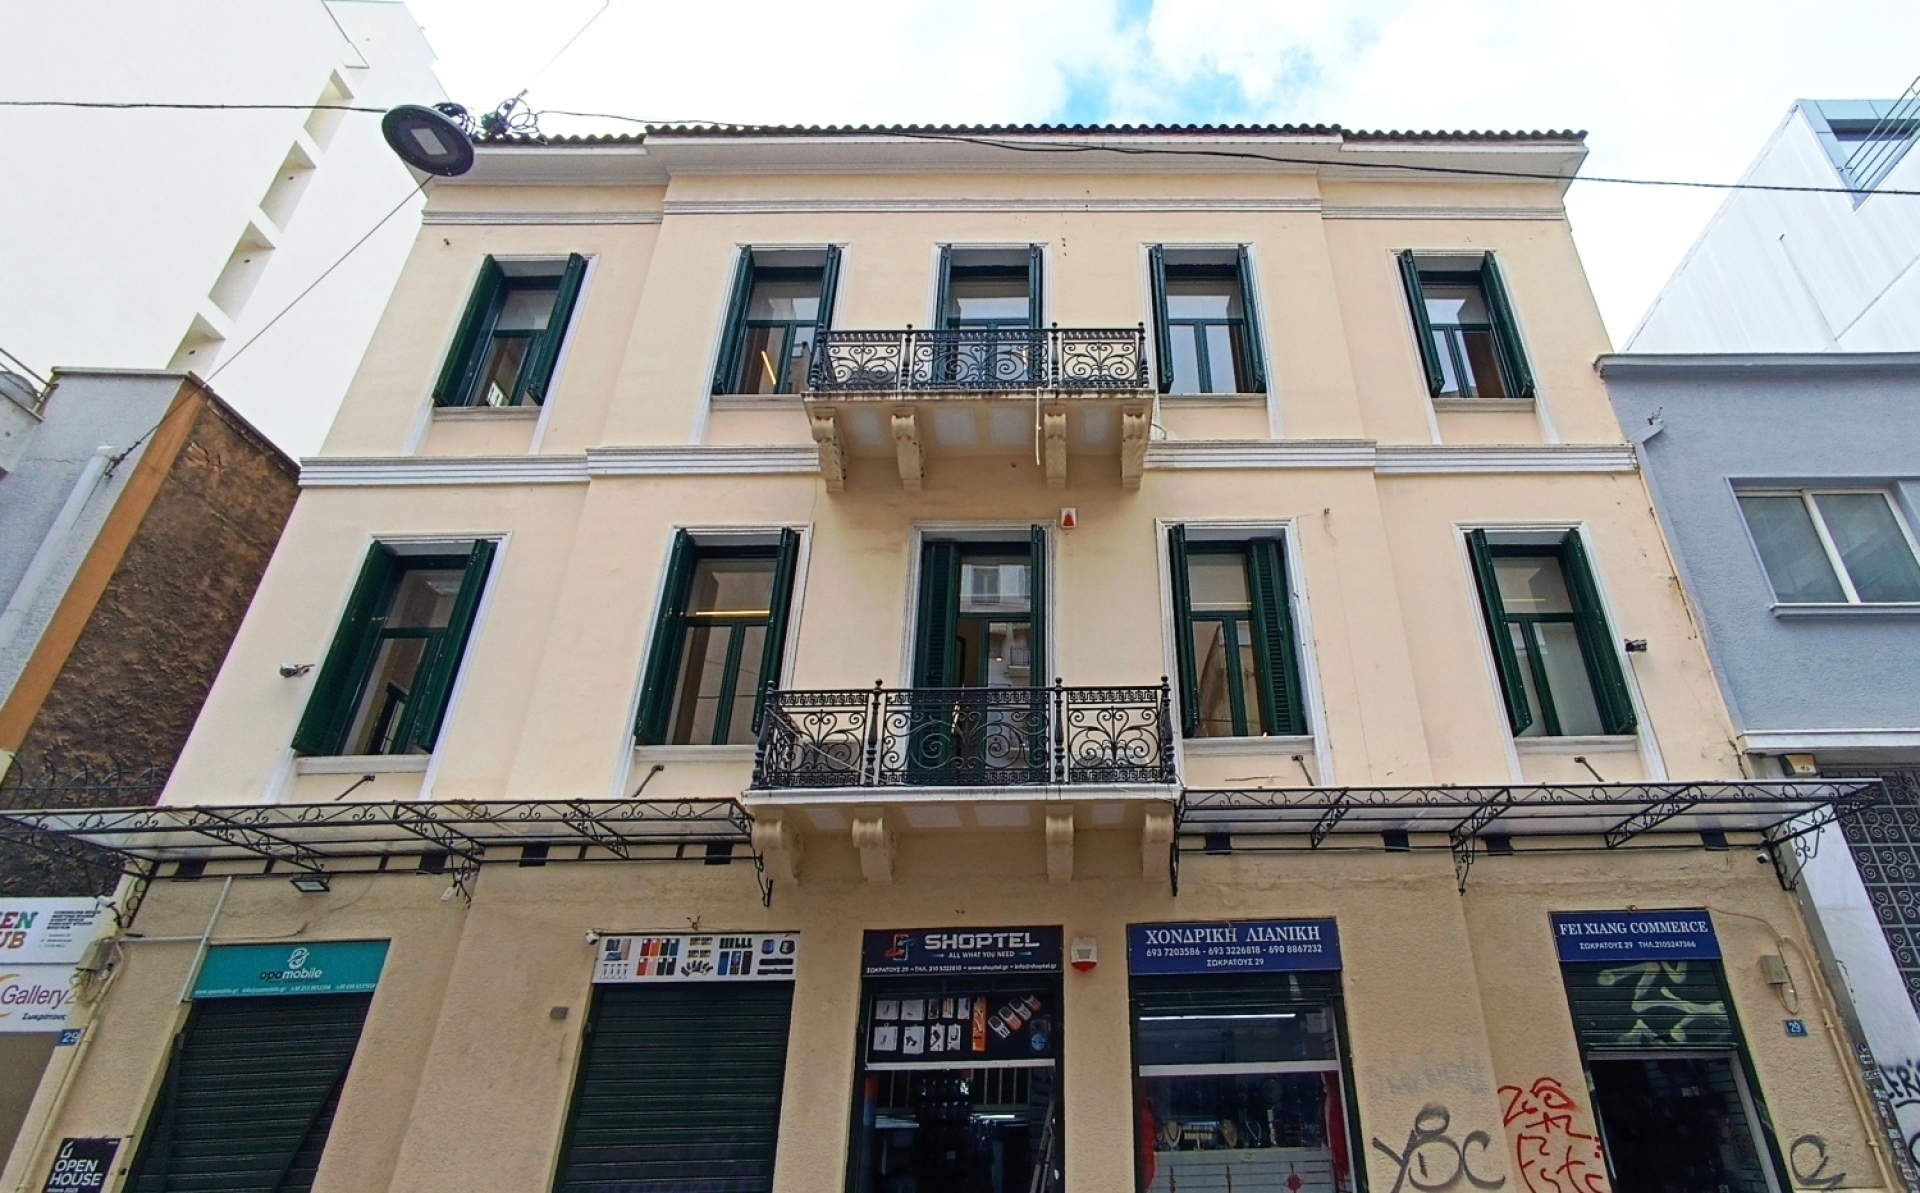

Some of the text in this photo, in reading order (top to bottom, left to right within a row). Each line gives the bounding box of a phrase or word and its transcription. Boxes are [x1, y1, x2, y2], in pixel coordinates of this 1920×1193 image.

[0, 911, 39, 929] EN
[1559, 921, 1709, 935] FEI XIANG COMMERCE
[924, 932, 1040, 949] SHOPTEL
[1145, 926, 1321, 944] ΧΟΝΔΡΙΚΗ ΛΙΑΝΙΚΗ
[948, 951, 961, 959] ALL
[1146, 948, 1162, 957] 693
[1207, 946, 1224, 955] 693
[1268, 945, 1285, 954] 690
[1206, 958, 1264, 967] ΣΩΚΡΑΤΟΥΣ 29
[260, 968, 322, 982] opamobile
[1788, 1022, 1802, 1033] 29
[61, 1032, 79, 1043] 29
[55, 1159, 98, 1172] OPEN
[49, 1173, 103, 1186] HOUSE
